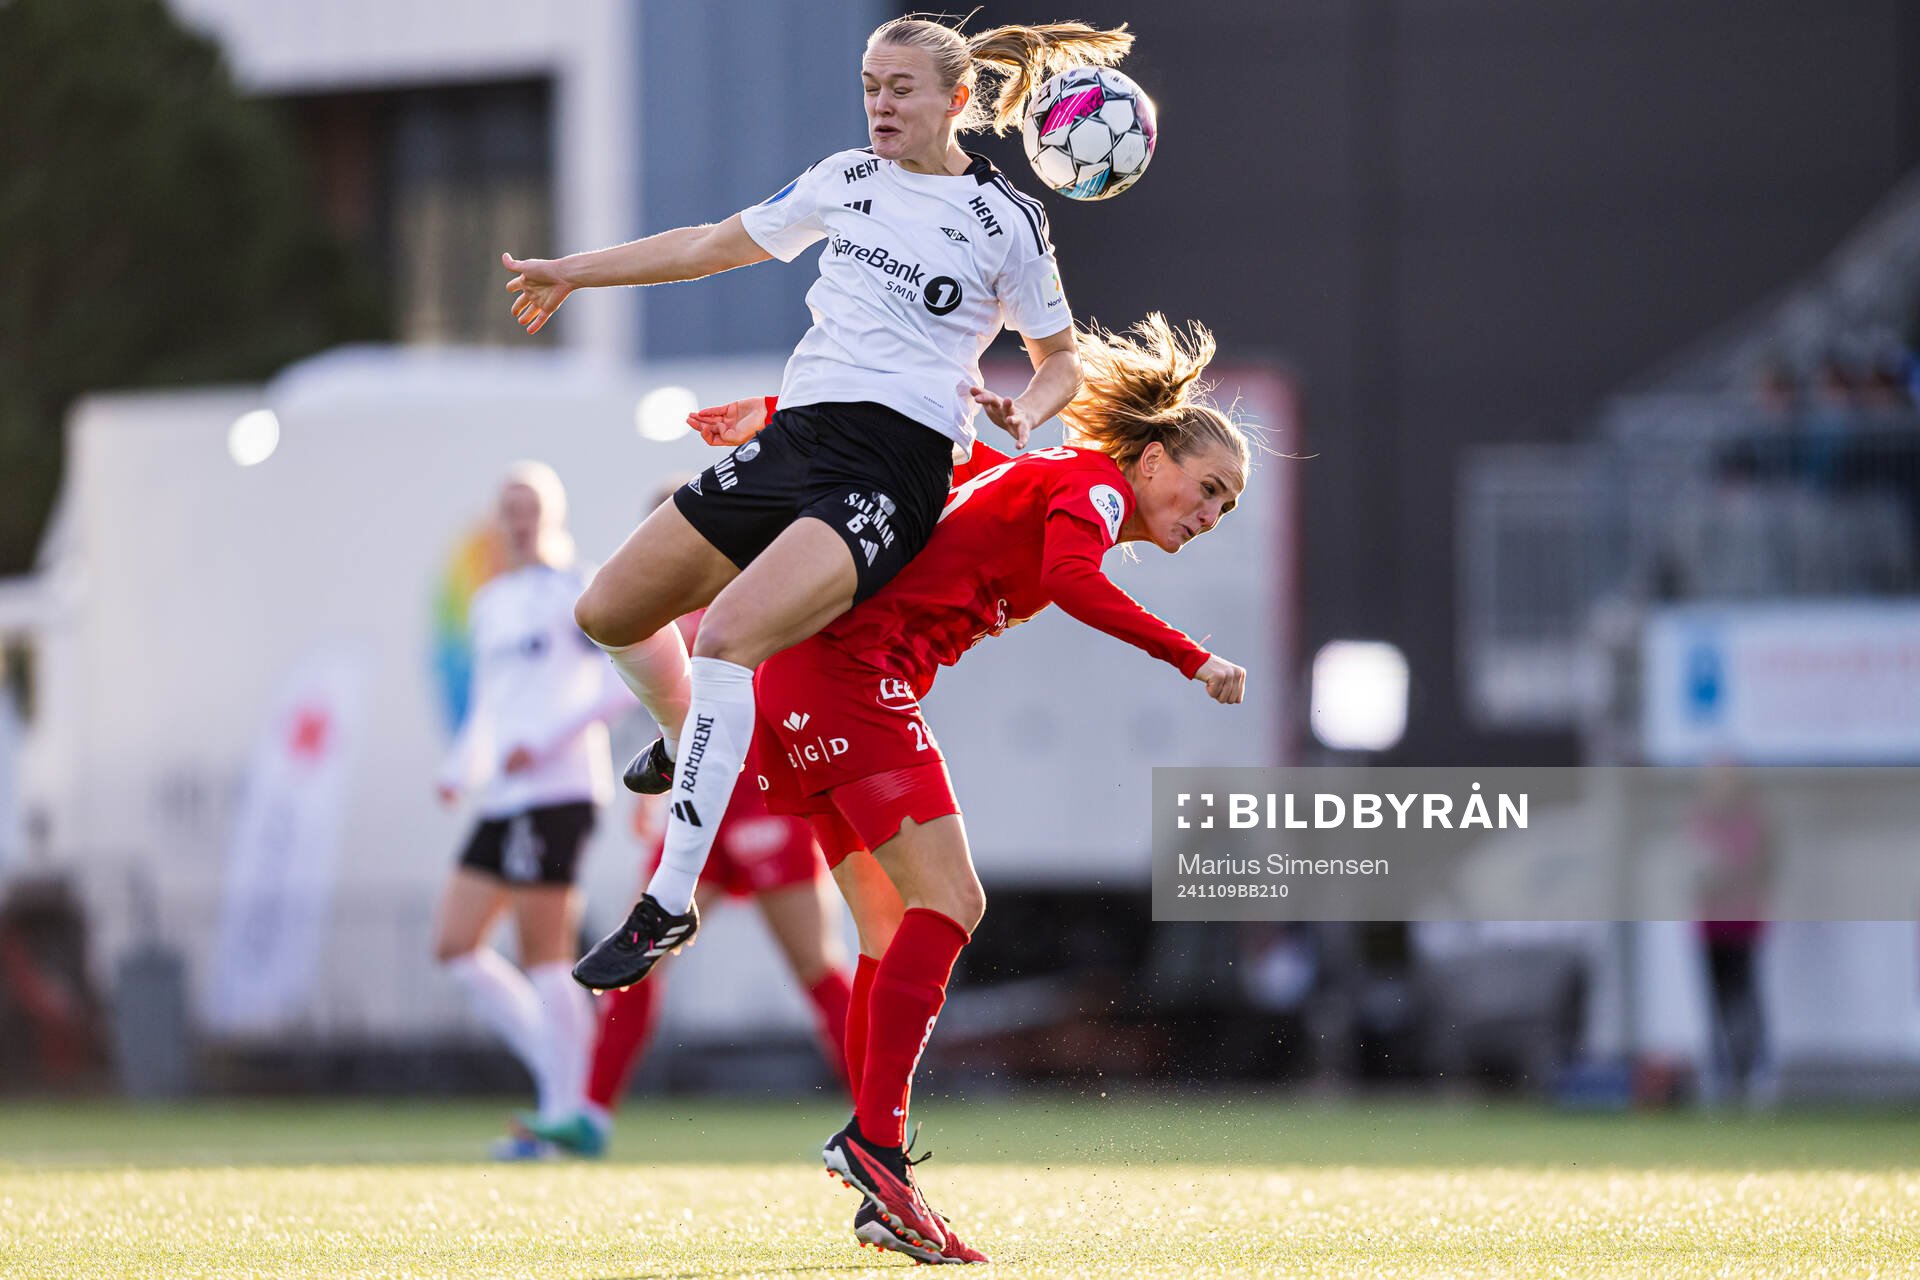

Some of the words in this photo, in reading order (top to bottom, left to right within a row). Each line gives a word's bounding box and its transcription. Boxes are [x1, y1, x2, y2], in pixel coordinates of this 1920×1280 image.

[844, 158, 881, 184] HENT
[968, 195, 1003, 237] HENT
[832, 234, 925, 288] pareBank
[884, 280, 917, 302] SMN
[844, 492, 895, 549] SALMAR
[846, 513, 870, 534] 6
[681, 713, 714, 794] RAMIRENT
